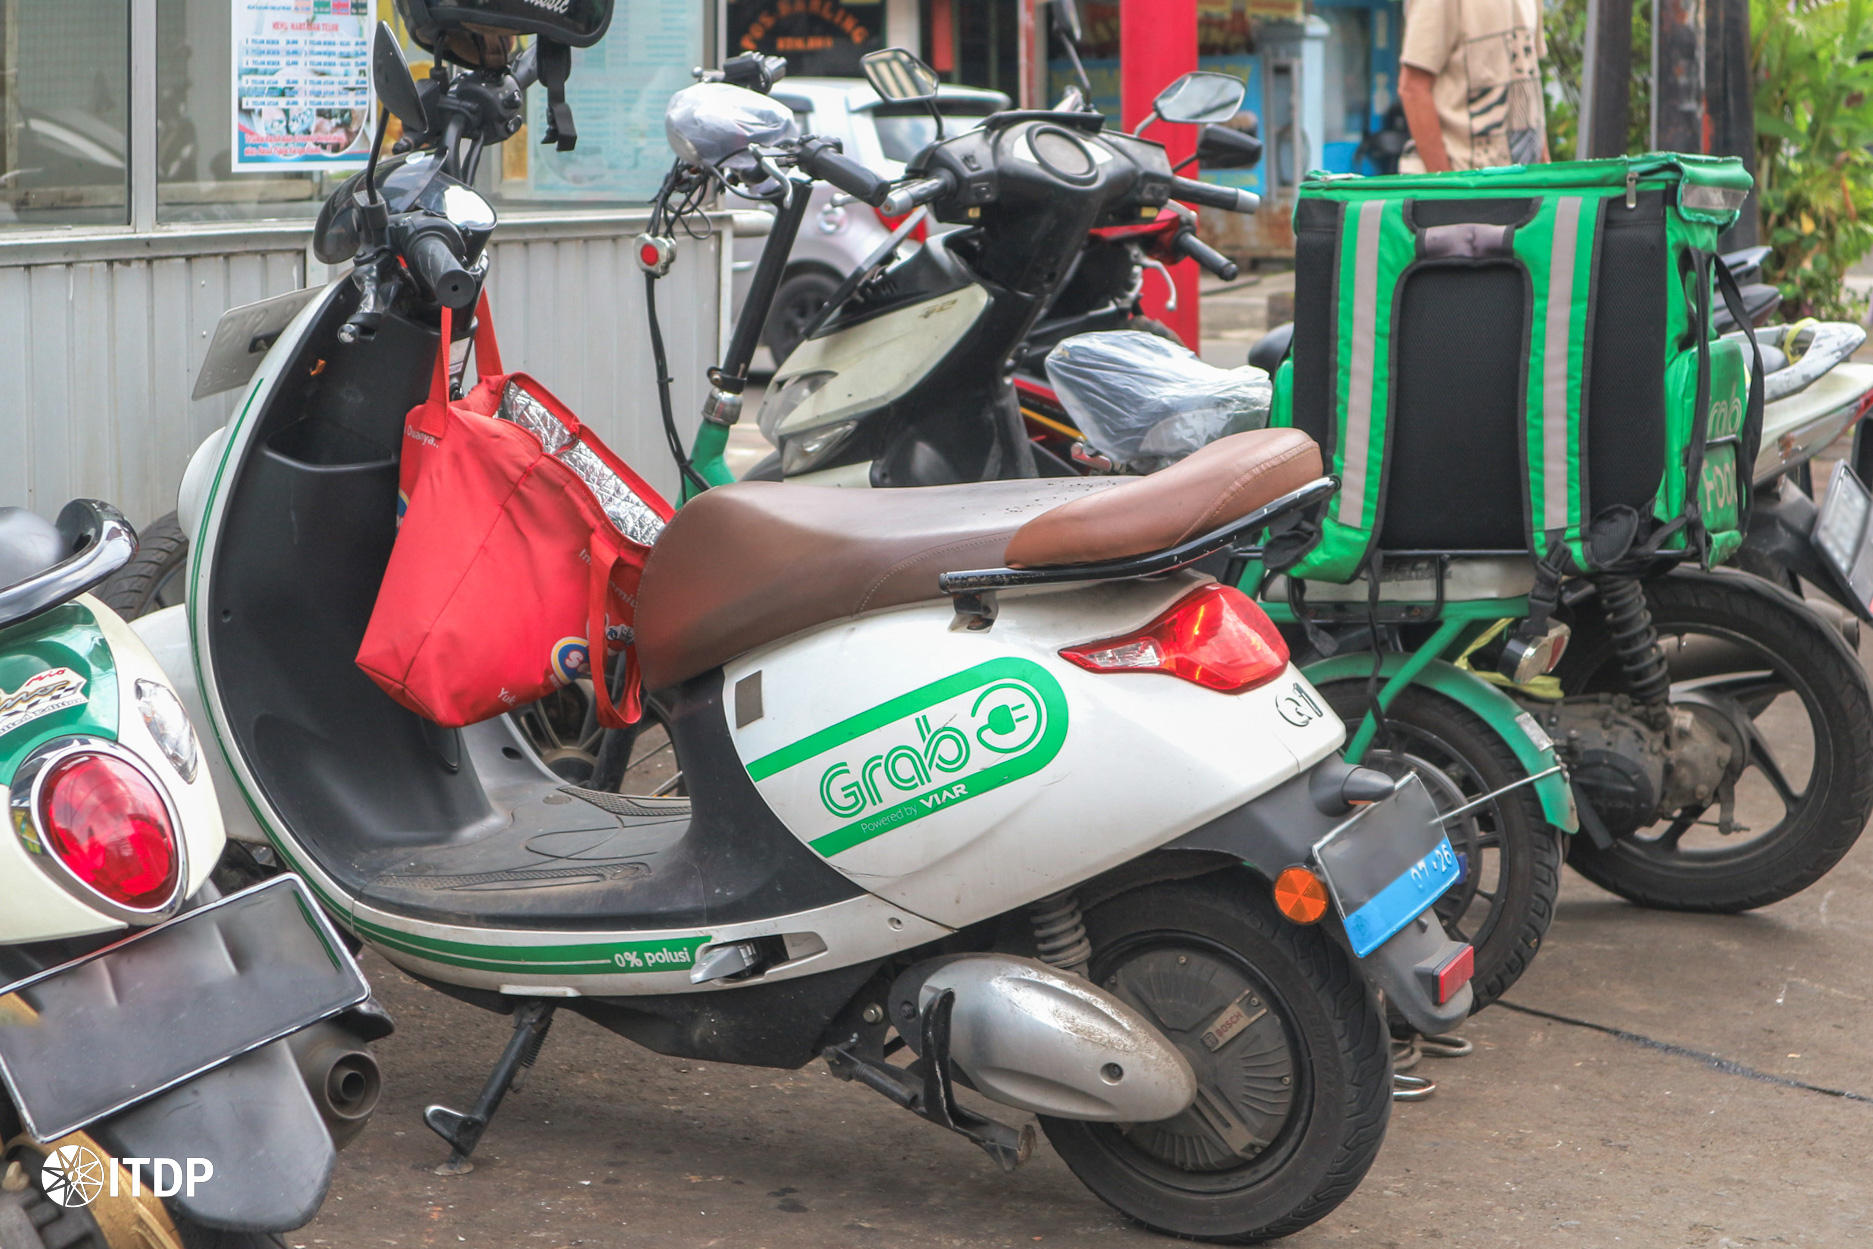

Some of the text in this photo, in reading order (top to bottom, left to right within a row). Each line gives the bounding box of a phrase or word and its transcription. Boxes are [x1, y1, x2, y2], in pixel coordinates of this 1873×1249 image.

[819, 714, 971, 819] Grab
[860, 783, 969, 834] Powered by VIAR
[613, 946, 692, 968] 0% polusi
[1215, 1011, 1244, 1038] BOSCH
